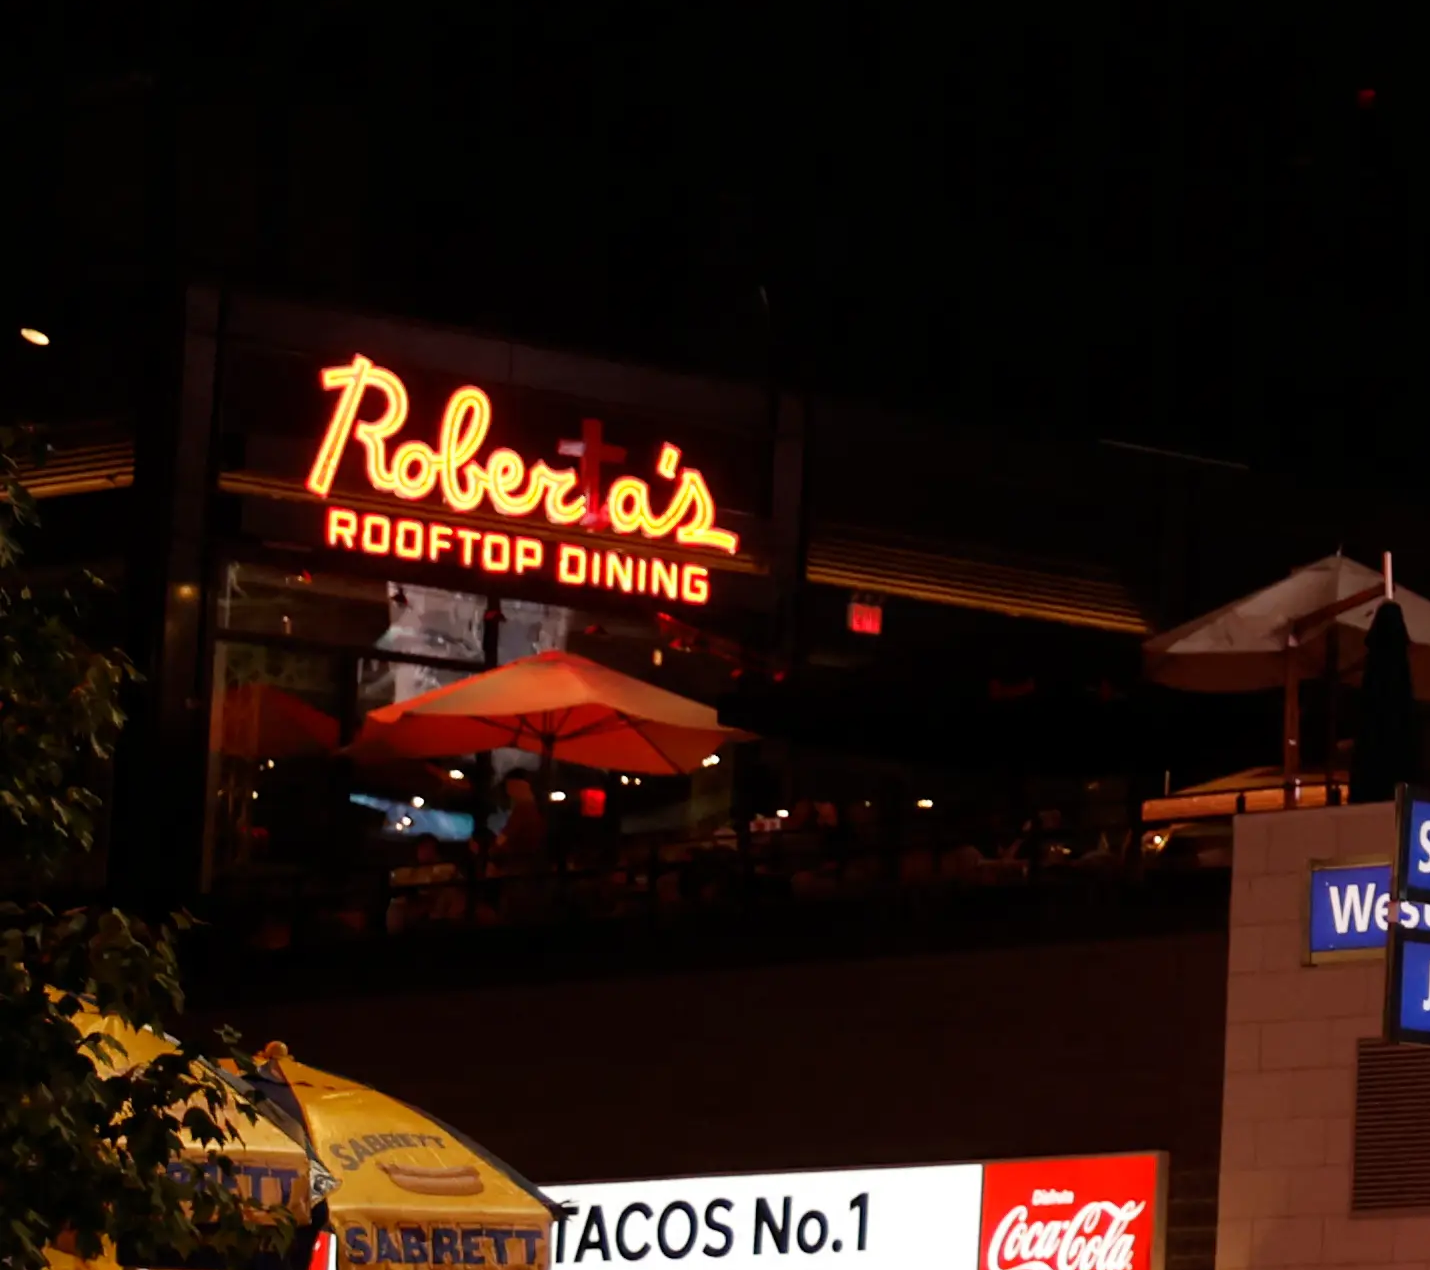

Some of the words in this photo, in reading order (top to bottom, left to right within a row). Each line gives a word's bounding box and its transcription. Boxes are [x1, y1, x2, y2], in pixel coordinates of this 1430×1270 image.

[306, 354, 737, 554] Roberta's
[327, 507, 544, 575] ROOFTOP
[558, 543, 709, 604] DINING
[329, 1133, 447, 1171] SABRETT
[344, 1227, 545, 1266] SABRETT
[553, 1196, 733, 1264] TACOS
[753, 1192, 869, 1256] No.1
